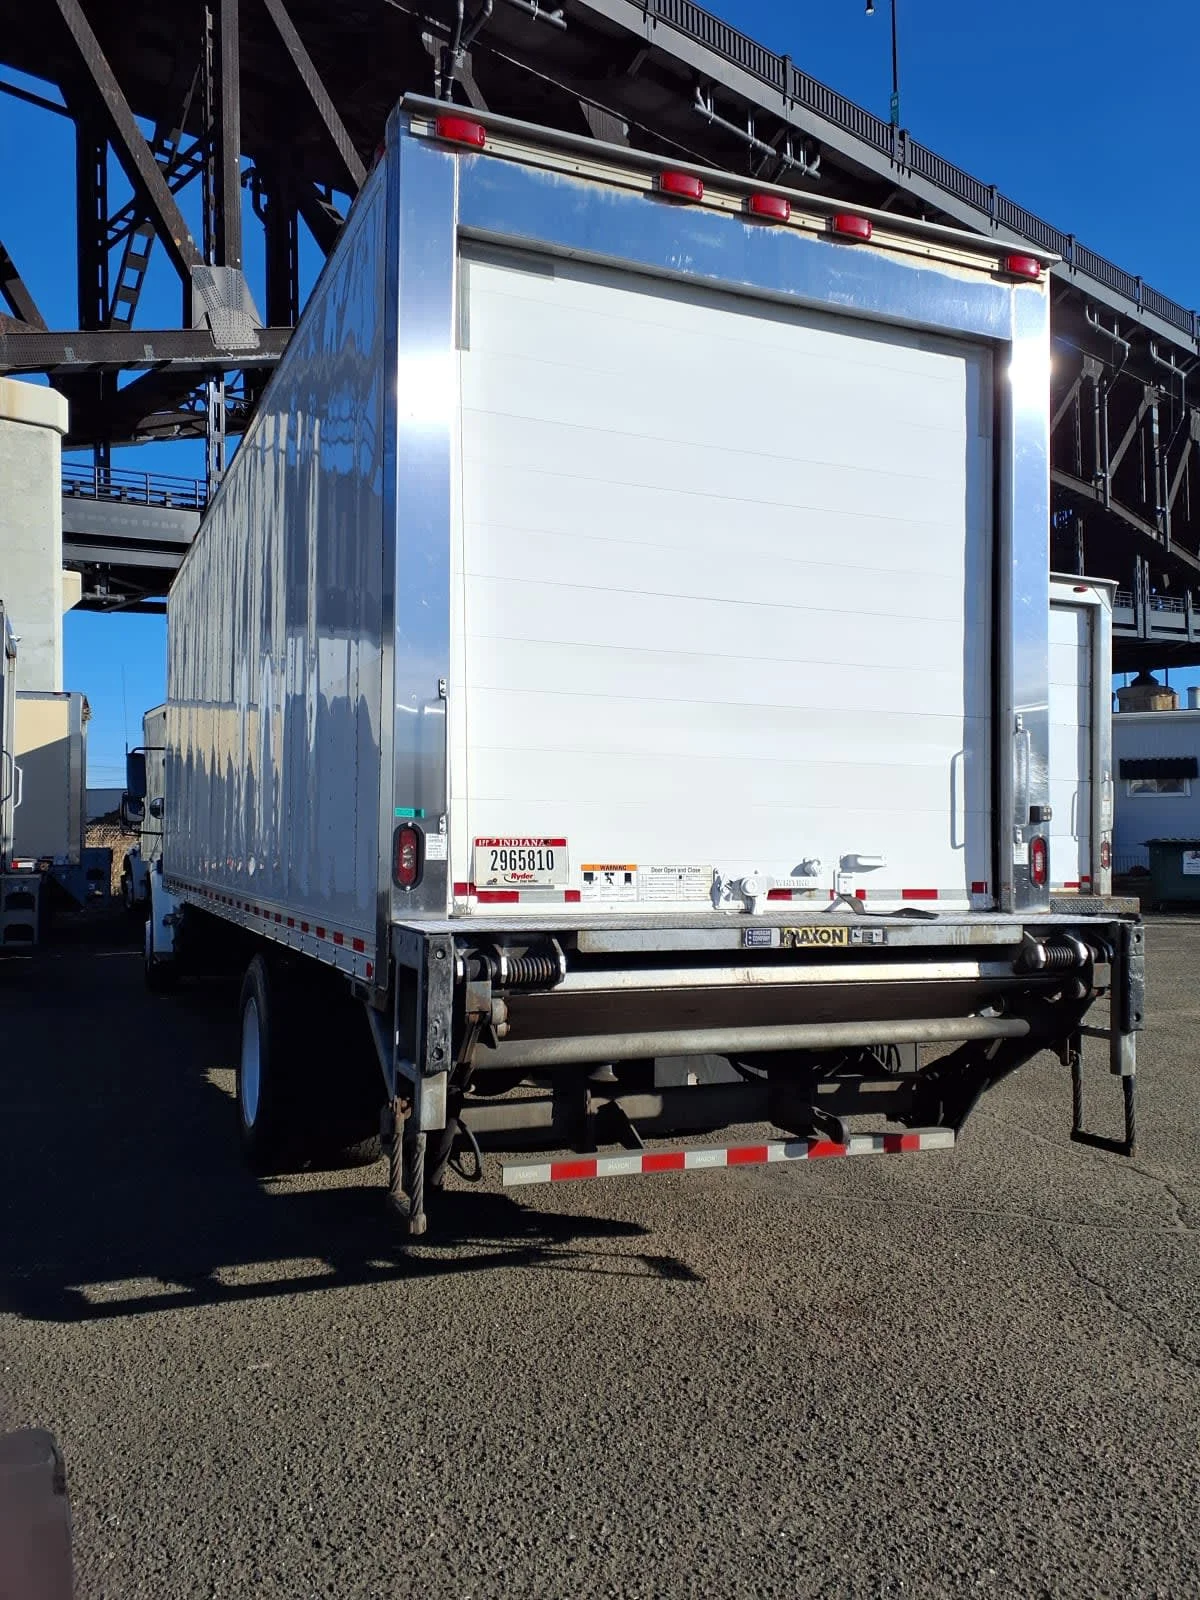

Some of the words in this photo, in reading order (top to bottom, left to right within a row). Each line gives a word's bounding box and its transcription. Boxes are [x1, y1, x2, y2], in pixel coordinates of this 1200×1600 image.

[499, 839, 546, 847] INDIANA
[490, 849, 554, 871] 2965810
[510, 873, 534, 881] Ryder
